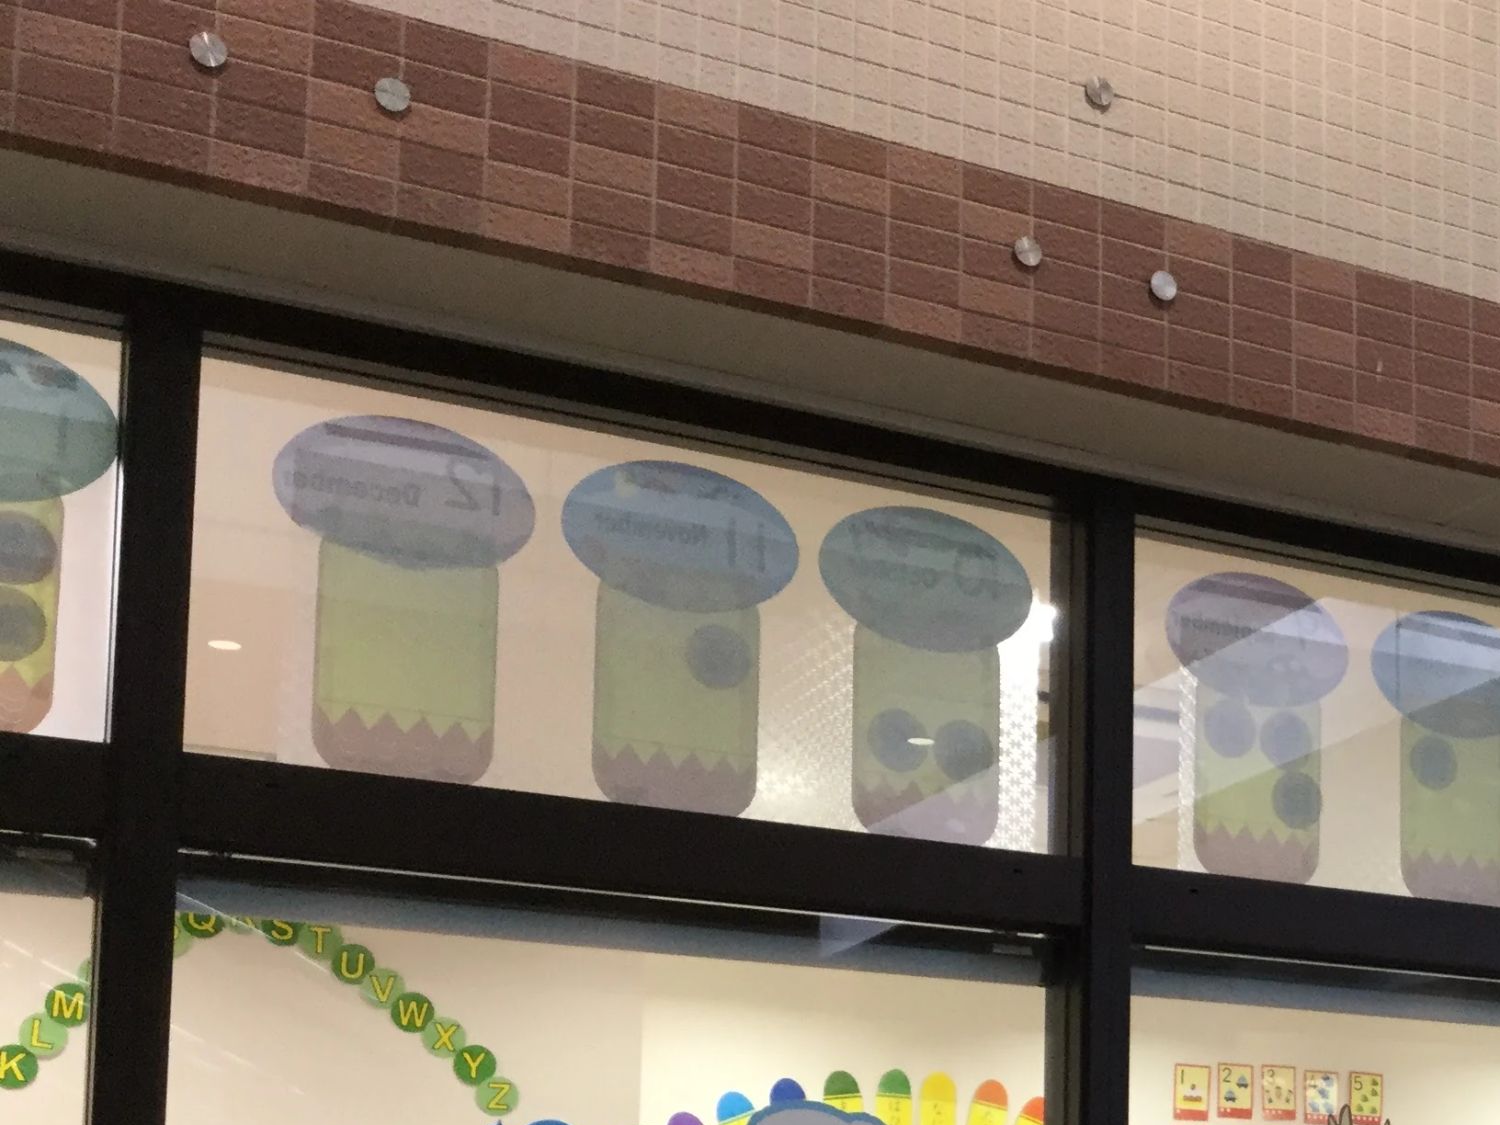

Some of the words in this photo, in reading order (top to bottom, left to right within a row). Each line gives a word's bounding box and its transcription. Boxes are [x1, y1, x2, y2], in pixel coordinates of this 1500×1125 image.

[0, 1051, 25, 1082] K
[31, 1019, 54, 1049] L
[52, 991, 85, 1020] M
[270, 920, 294, 942] S
[310, 926, 332, 954] T
[340, 952, 366, 979] U
[369, 976, 394, 1003] V
[397, 1003, 429, 1028] W
[431, 1024, 457, 1051] X
[462, 1052, 485, 1080] Y
[487, 1083, 511, 1110] Z
[1221, 1067, 1233, 1084] 2
[1353, 1075, 1364, 1091] 5
